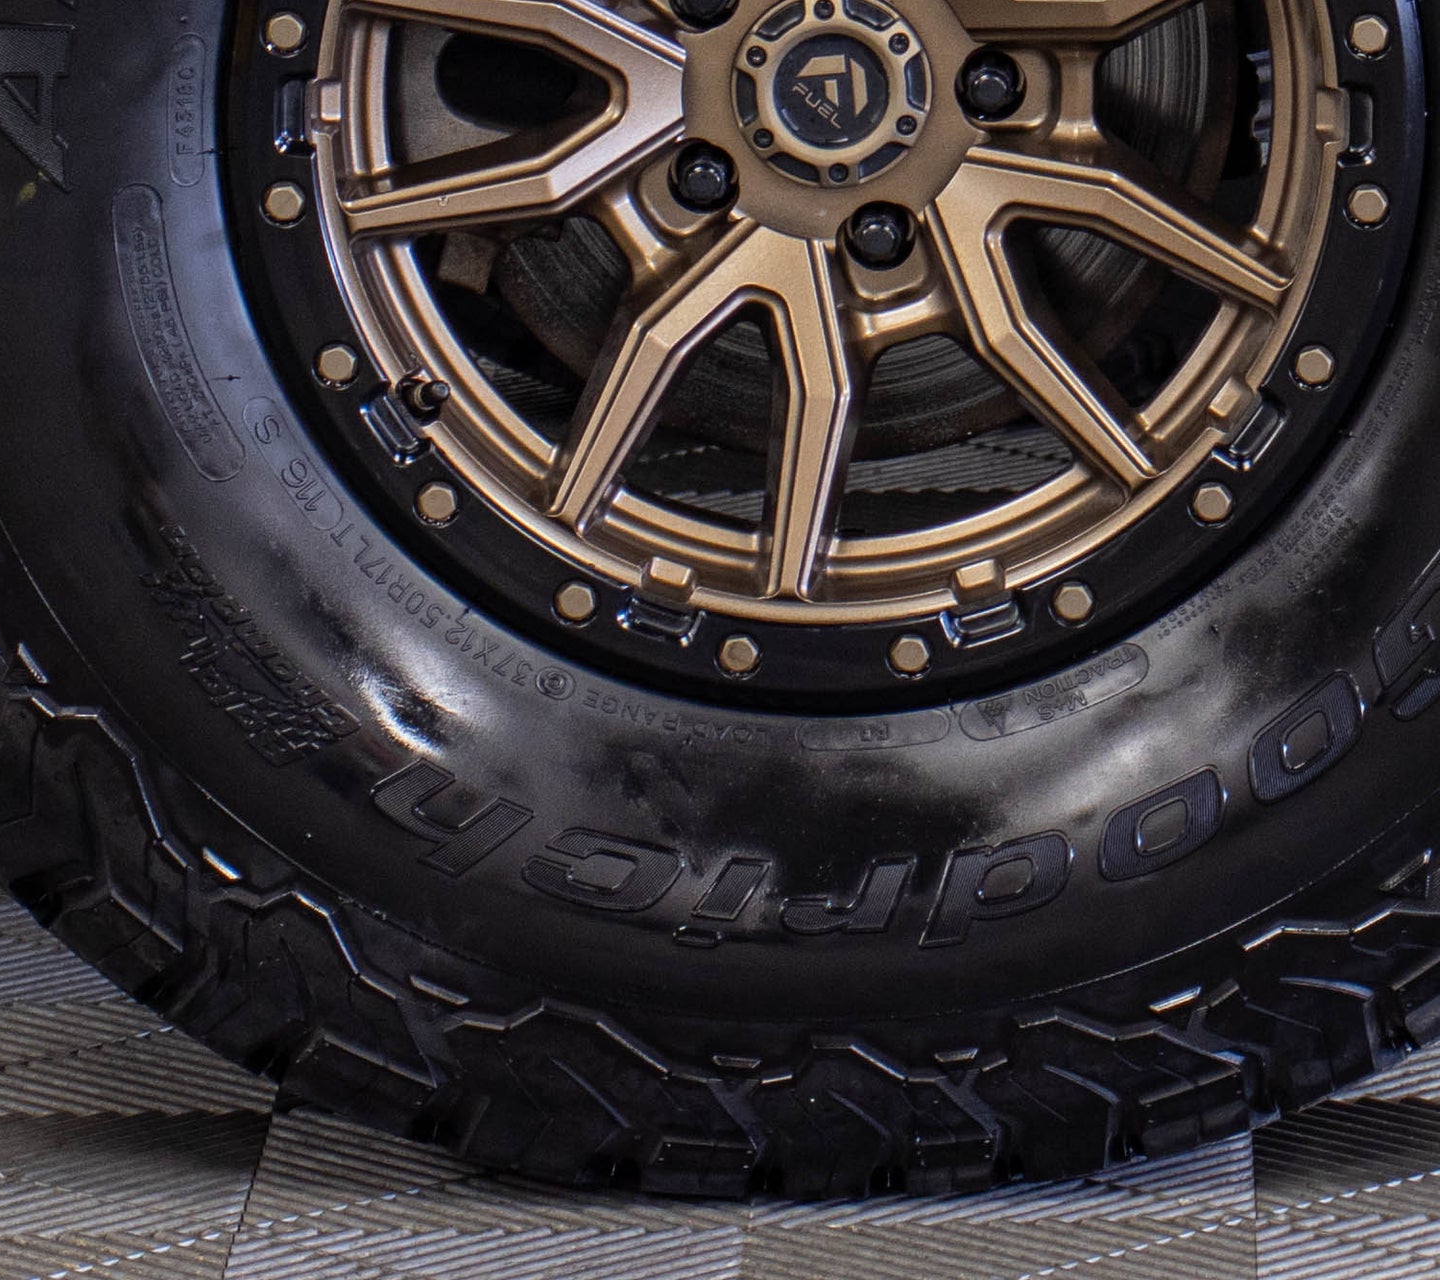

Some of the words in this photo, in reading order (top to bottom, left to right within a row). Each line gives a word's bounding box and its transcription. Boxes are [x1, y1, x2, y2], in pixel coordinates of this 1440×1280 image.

[791, 82, 842, 130] FUEL
[248, 411, 286, 450] S
[274, 451, 333, 516] 116
[325, 515, 539, 690] 37X12.50R17LT
[1018, 642, 1140, 708] TRACTION
[579, 683, 680, 735] RANGE
[1032, 687, 1091, 725] M+S
